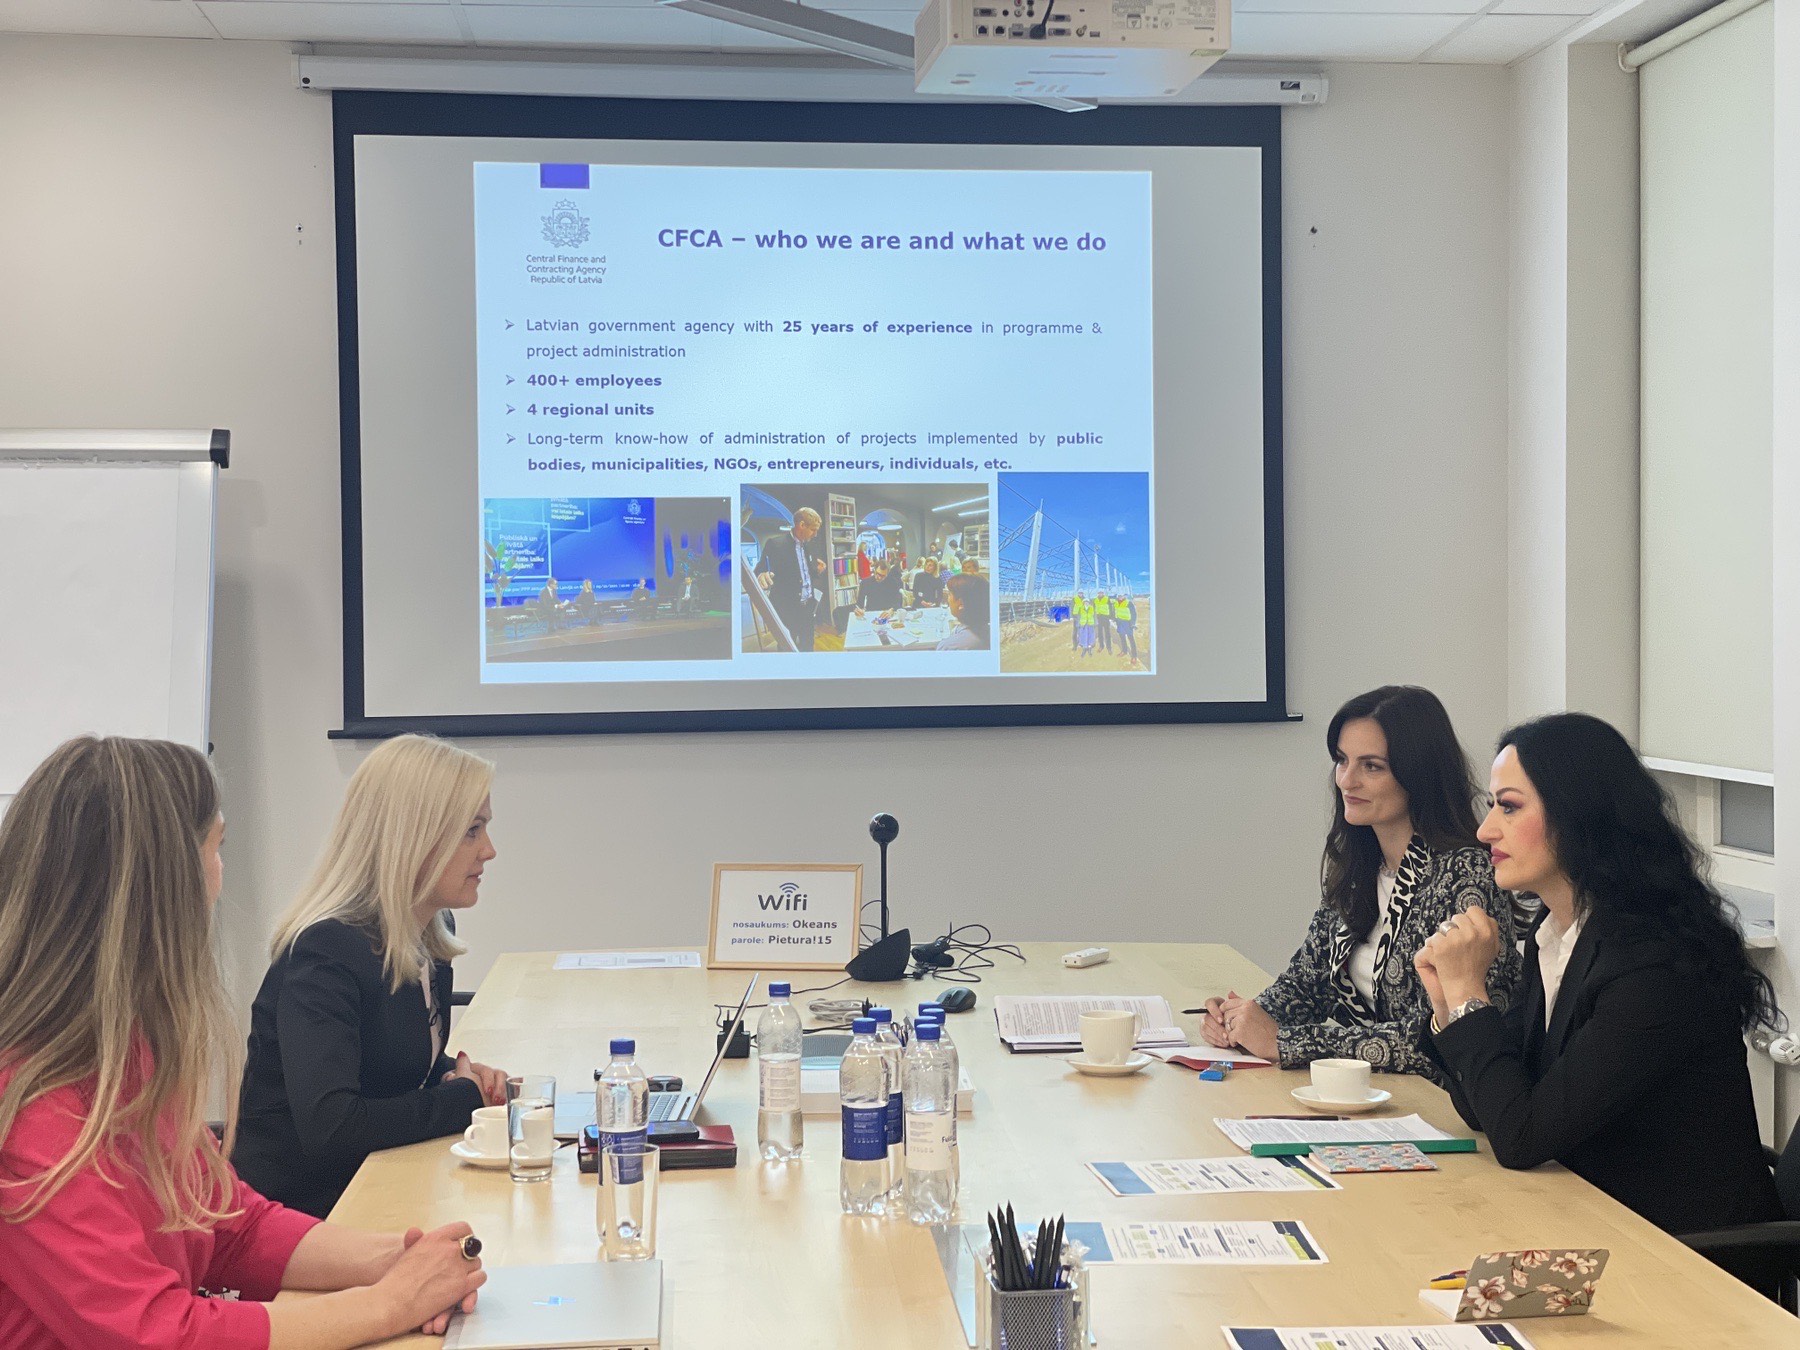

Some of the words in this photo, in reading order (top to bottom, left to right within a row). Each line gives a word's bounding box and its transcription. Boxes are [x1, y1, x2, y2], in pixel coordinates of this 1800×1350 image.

[658, 228, 723, 247] CFCA
[754, 229, 807, 248] who
[815, 234, 852, 249] we
[860, 235, 900, 249] are
[909, 231, 953, 249] and
[962, 231, 1024, 250] what
[1032, 236, 1068, 250] we
[1076, 232, 1106, 250] do
[525, 254, 555, 262] Central
[557, 254, 588, 263] Finance
[590, 254, 606, 263] and
[526, 264, 573, 275] Contracting
[575, 265, 606, 275] Agency
[530, 275, 565, 284] Republic
[566, 275, 576, 283] of
[577, 275, 602, 283] Latvia
[526, 318, 578, 331] Latvian
[588, 319, 675, 334] government
[684, 322, 734, 334] agency
[743, 319, 773, 332] with
[782, 320, 802, 332] 25
[810, 323, 854, 335] years
[862, 320, 879, 332] of
[886, 320, 972, 335] experience
[981, 321, 993, 333] in
[1003, 324, 1082, 336] programme
[1091, 322, 1102, 333] &
[526, 344, 578, 359] project
[582, 344, 685, 357] administration
[526, 374, 569, 386] 400+
[575, 373, 662, 389] employees
[527, 403, 537, 415] 4
[542, 402, 608, 418] regional
[614, 402, 654, 415] units
[528, 432, 603, 447] Long-term
[615, 431, 688, 444] know-how
[699, 431, 714, 444] of
[724, 431, 825, 444] administration
[836, 431, 850, 444] of
[861, 432, 916, 446] projects
[927, 431, 1017, 446] implemented
[1029, 432, 1045, 446] by
[1056, 432, 1102, 446] public
[528, 458, 585, 472] bodies,
[591, 457, 708, 472] municipalities,
[714, 457, 762, 471] NGOs,
[767, 458, 884, 472] entrepreneurs,
[889, 457, 978, 471] individuals,
[983, 458, 1014, 471] etc.
[757, 892, 808, 911] Wifi
[732, 920, 788, 928] nosaukums:
[792, 919, 837, 928] Okeans
[731, 936, 763, 944] parole:
[768, 934, 831, 944] Pietura!15
